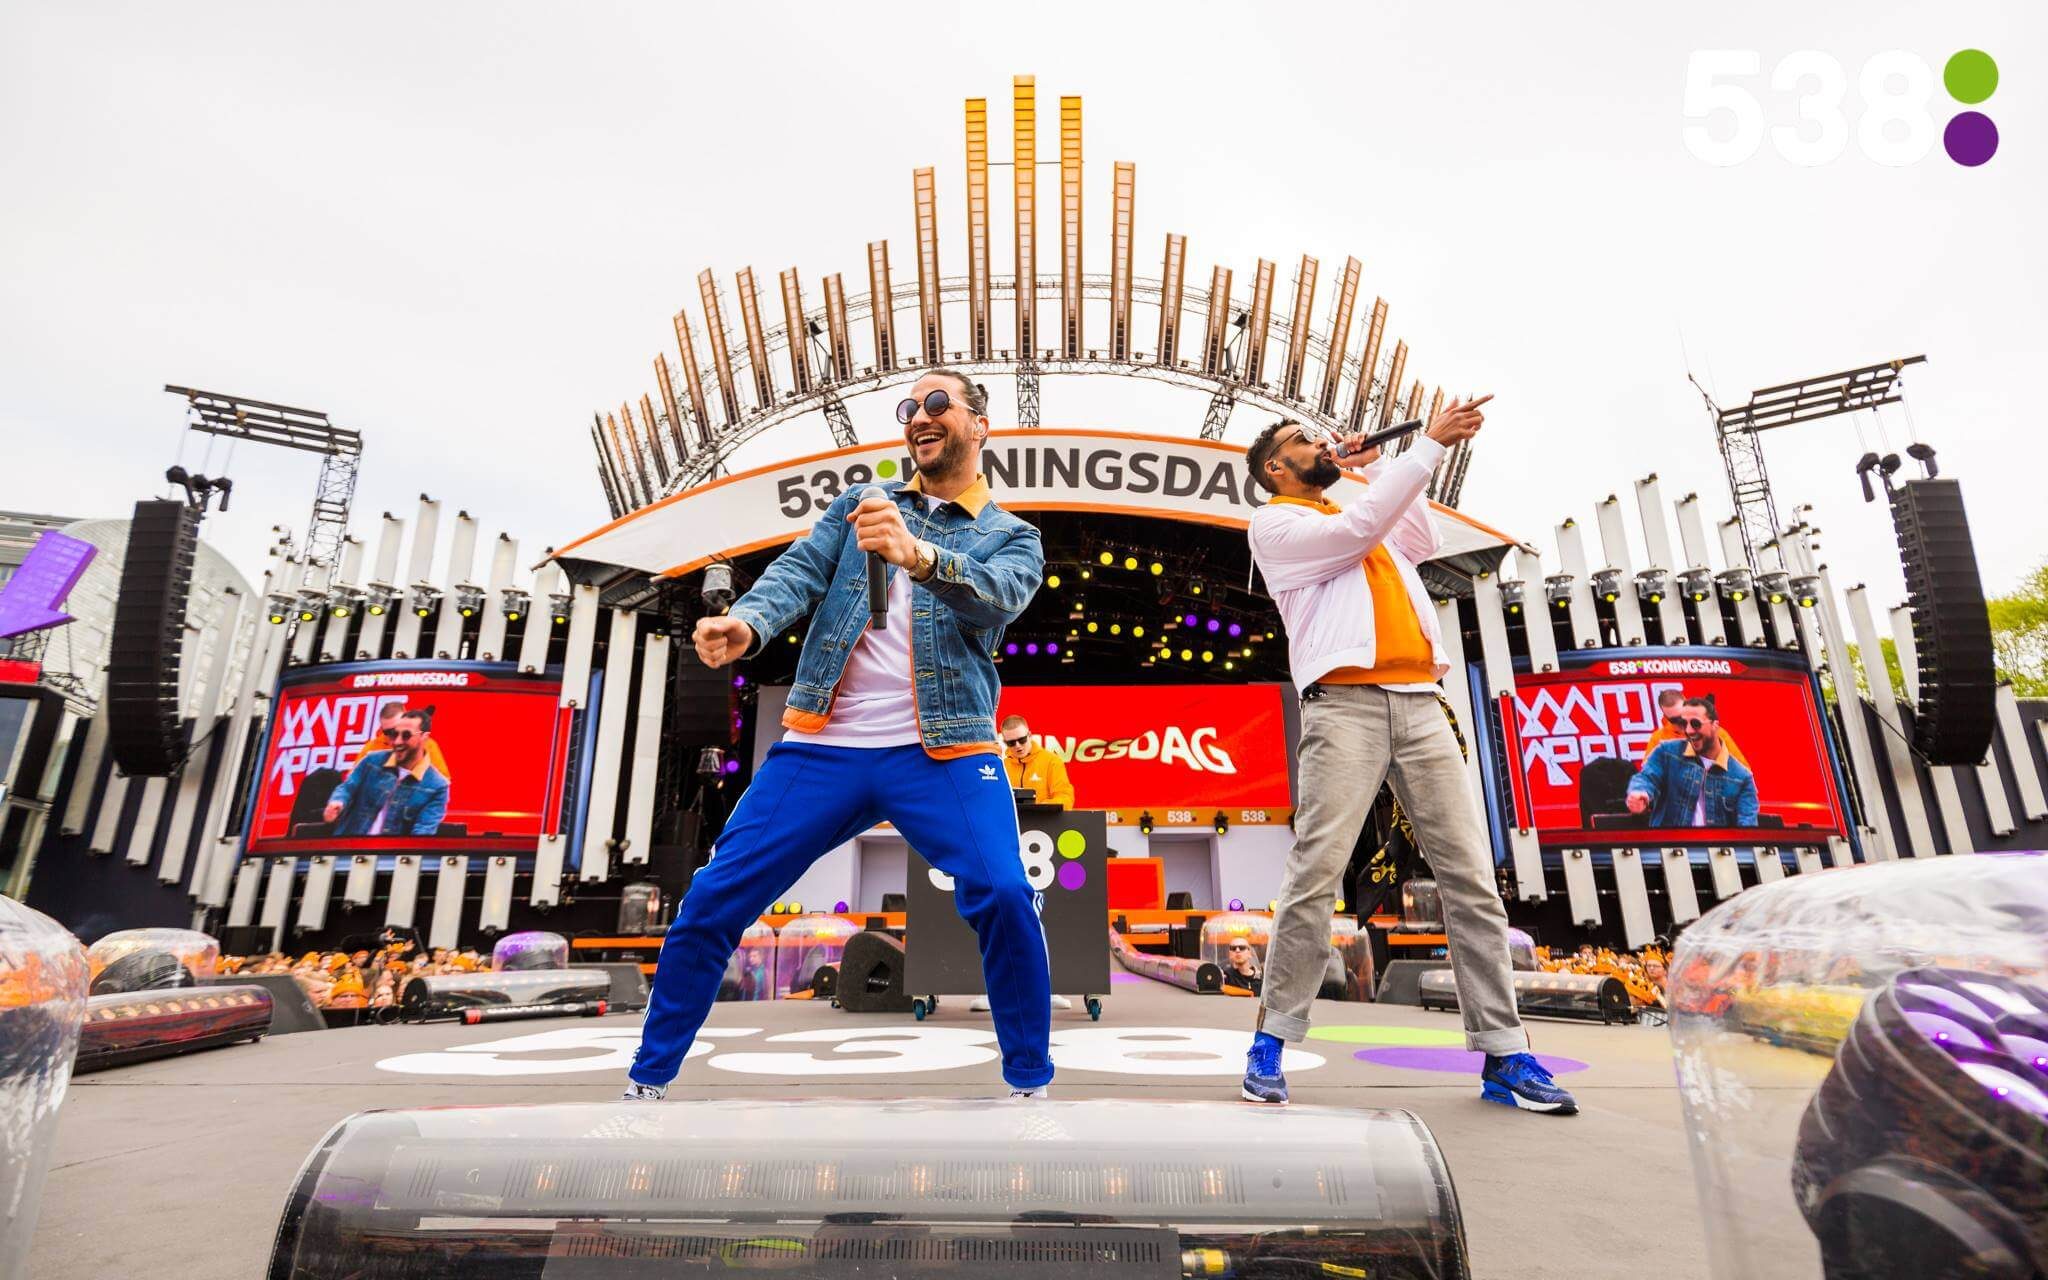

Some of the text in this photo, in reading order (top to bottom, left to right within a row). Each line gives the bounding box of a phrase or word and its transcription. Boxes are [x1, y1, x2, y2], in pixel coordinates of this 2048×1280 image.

[901, 448, 1272, 508] NINGSDA
[1609, 660, 1731, 675] 538 KONINGSDAG
[377, 673, 469, 686] KONINGSDAG
[1167, 811, 1192, 823] 538
[1241, 811, 1266, 823] 538
[374, 1026, 1327, 1075] 538
